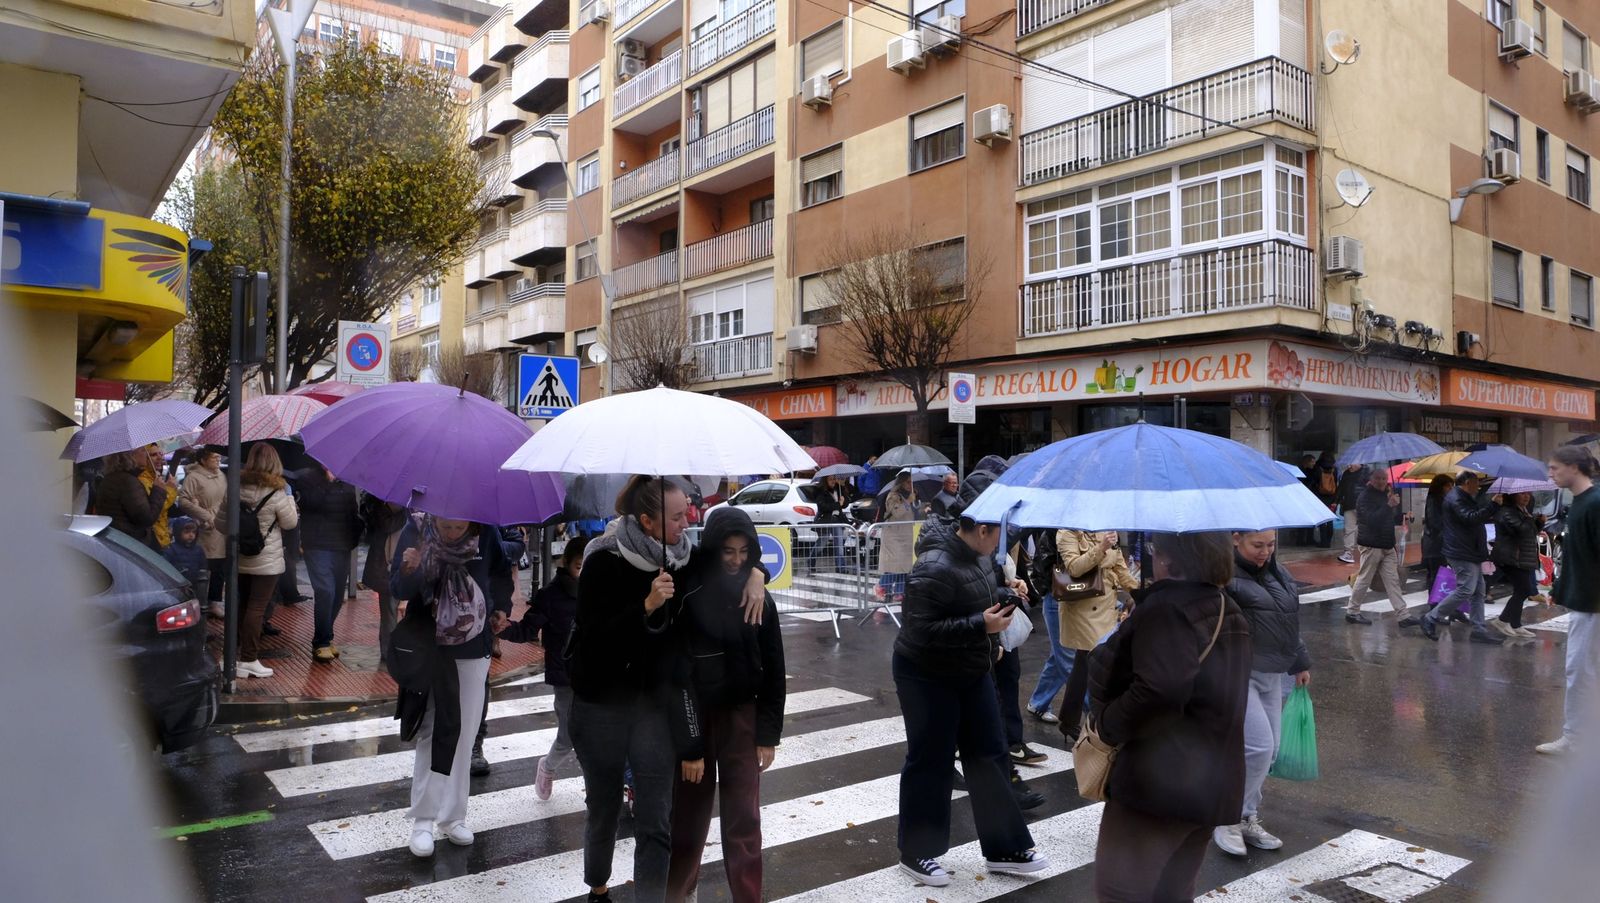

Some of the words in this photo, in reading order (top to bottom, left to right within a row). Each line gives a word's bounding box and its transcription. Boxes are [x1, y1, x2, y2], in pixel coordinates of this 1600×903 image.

[992, 367, 1077, 396] REGALO
[1149, 352, 1252, 385] HOGAR
[1305, 357, 1411, 393] HERRAMIENTAS
[780, 391, 826, 416] CHINA
[1459, 376, 1546, 410] SUPERMERCA
[1553, 389, 1589, 415] CHINA
